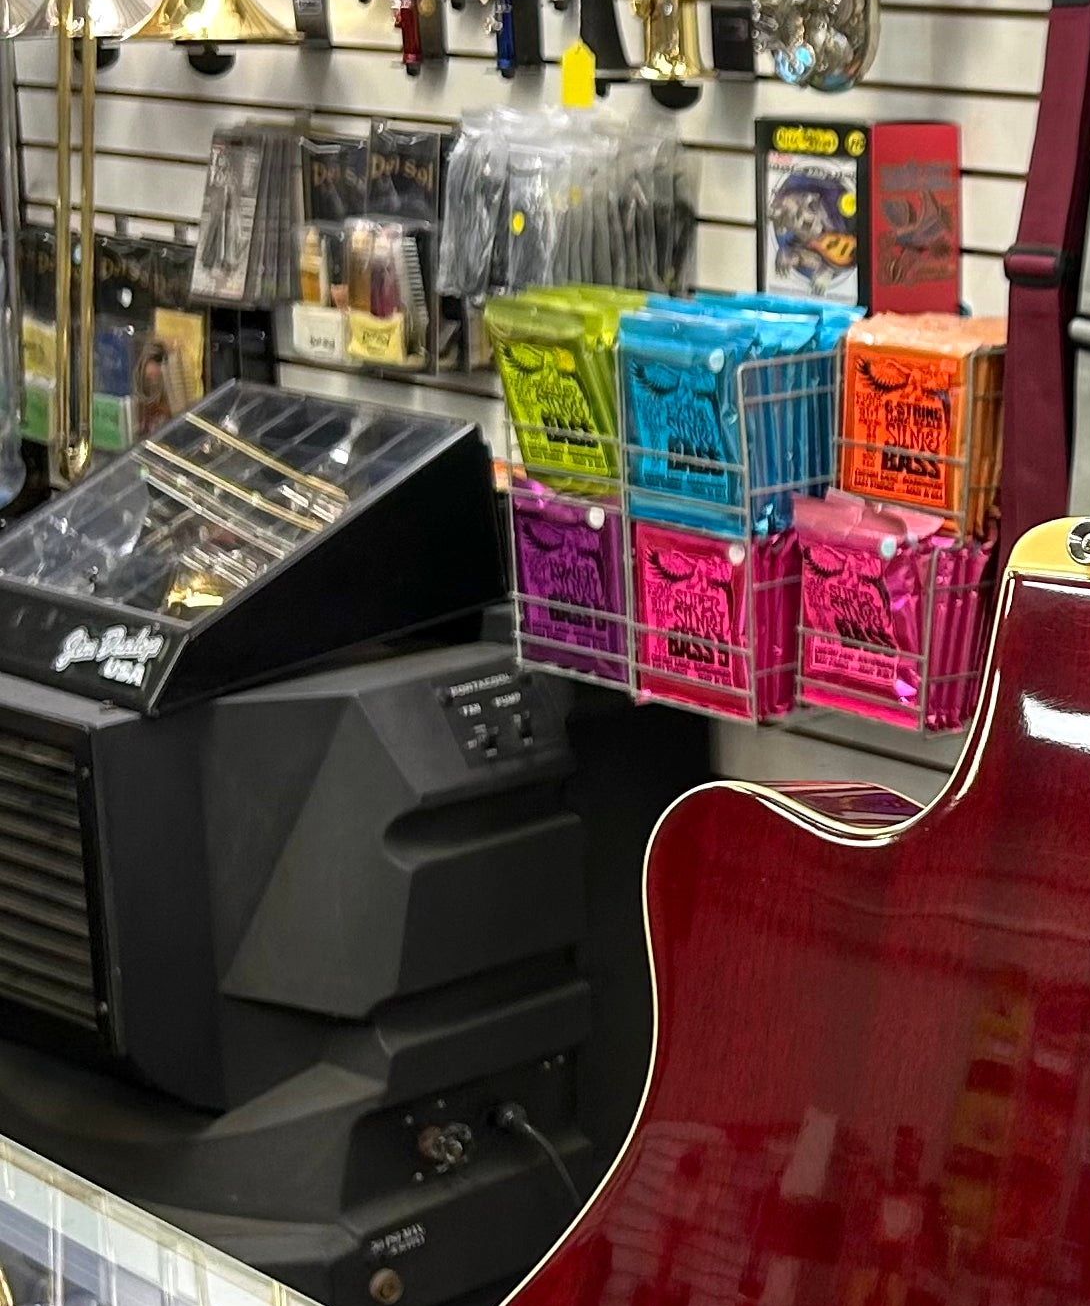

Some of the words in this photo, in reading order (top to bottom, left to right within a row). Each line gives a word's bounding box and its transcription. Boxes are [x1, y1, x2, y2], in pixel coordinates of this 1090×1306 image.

[370, 152, 401, 183] Del
[881, 445, 941, 480] BASS
[55, 625, 99, 672] Jim
[96, 624, 165, 664] Dunlop
[102, 656, 146, 687] USA
